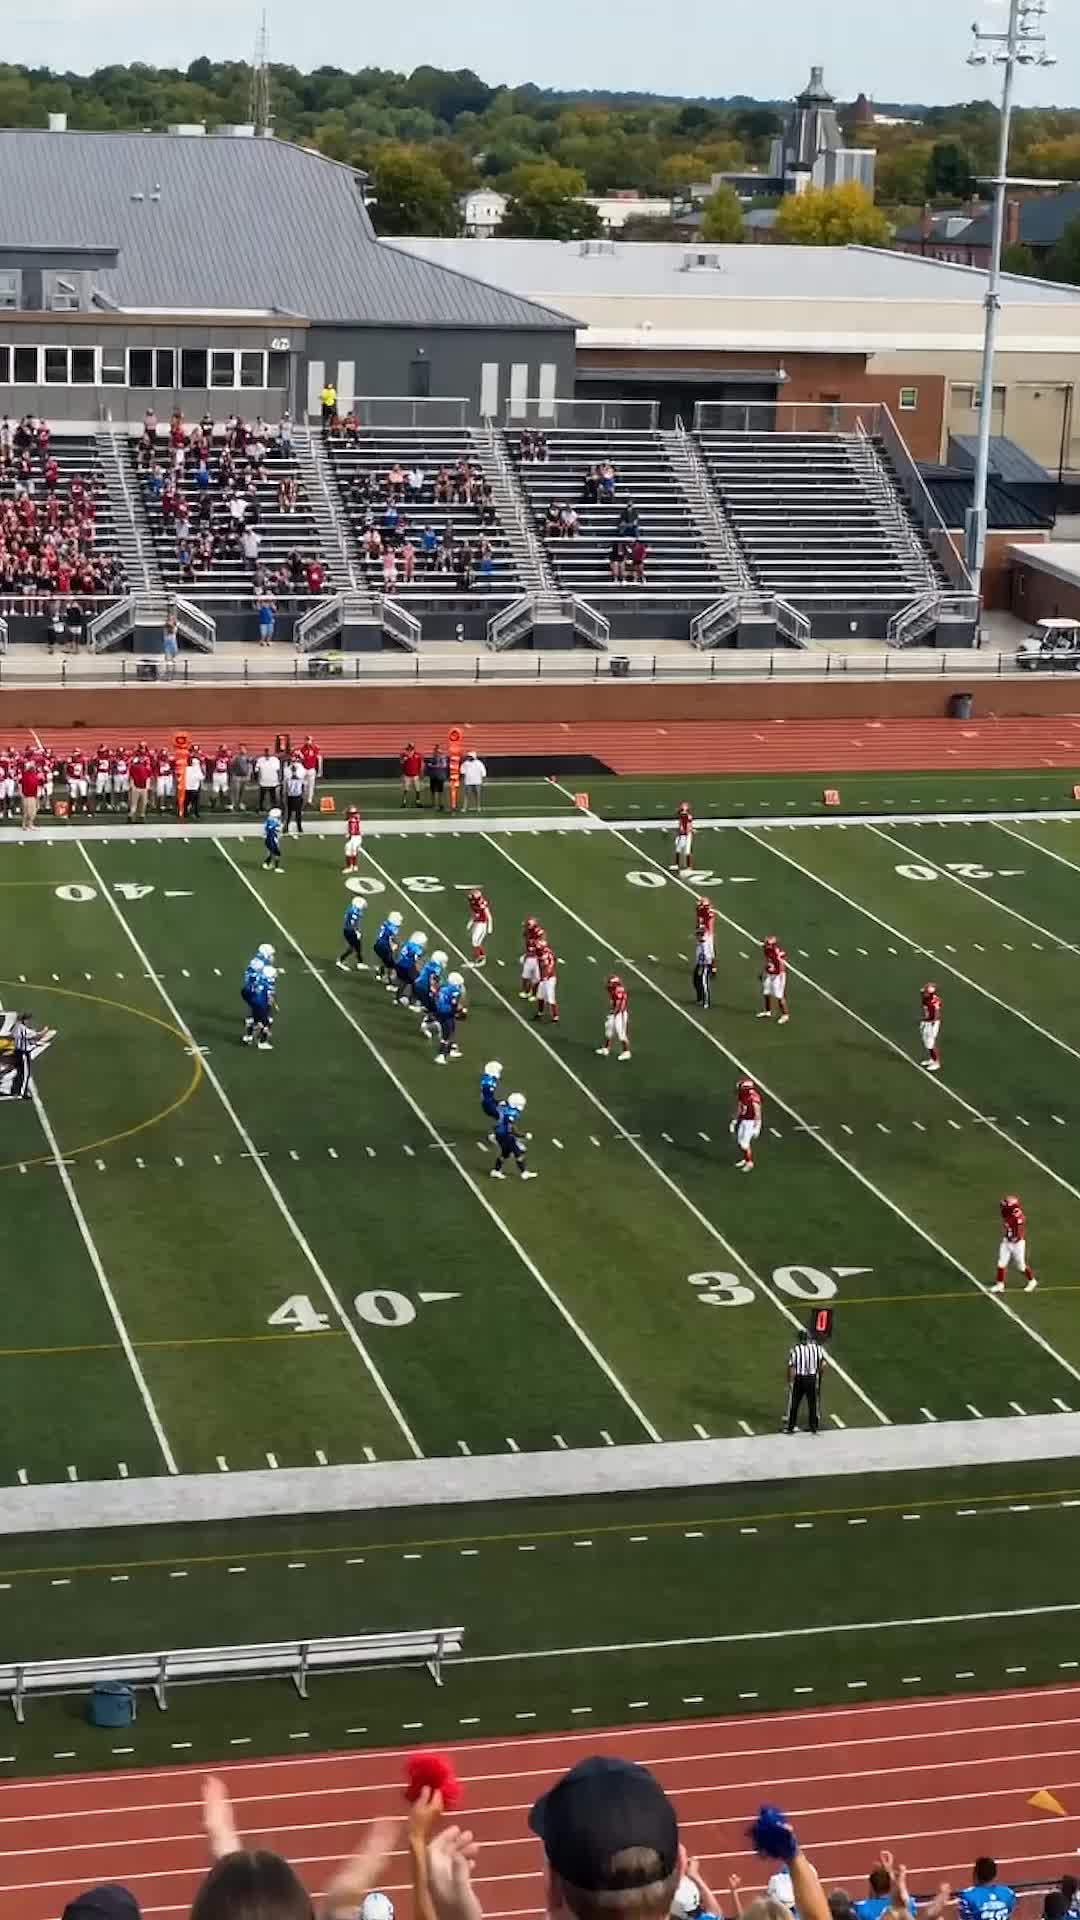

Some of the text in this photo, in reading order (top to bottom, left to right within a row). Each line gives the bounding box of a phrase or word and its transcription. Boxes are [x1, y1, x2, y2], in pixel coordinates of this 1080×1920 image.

[625, 870, 724, 887] 20
[894, 863, 994, 881] 20
[55, 883, 155, 901] 40
[345, 876, 446, 894] 30
[687, 1266, 838, 1306] 30
[267, 1290, 417, 1332] 40
